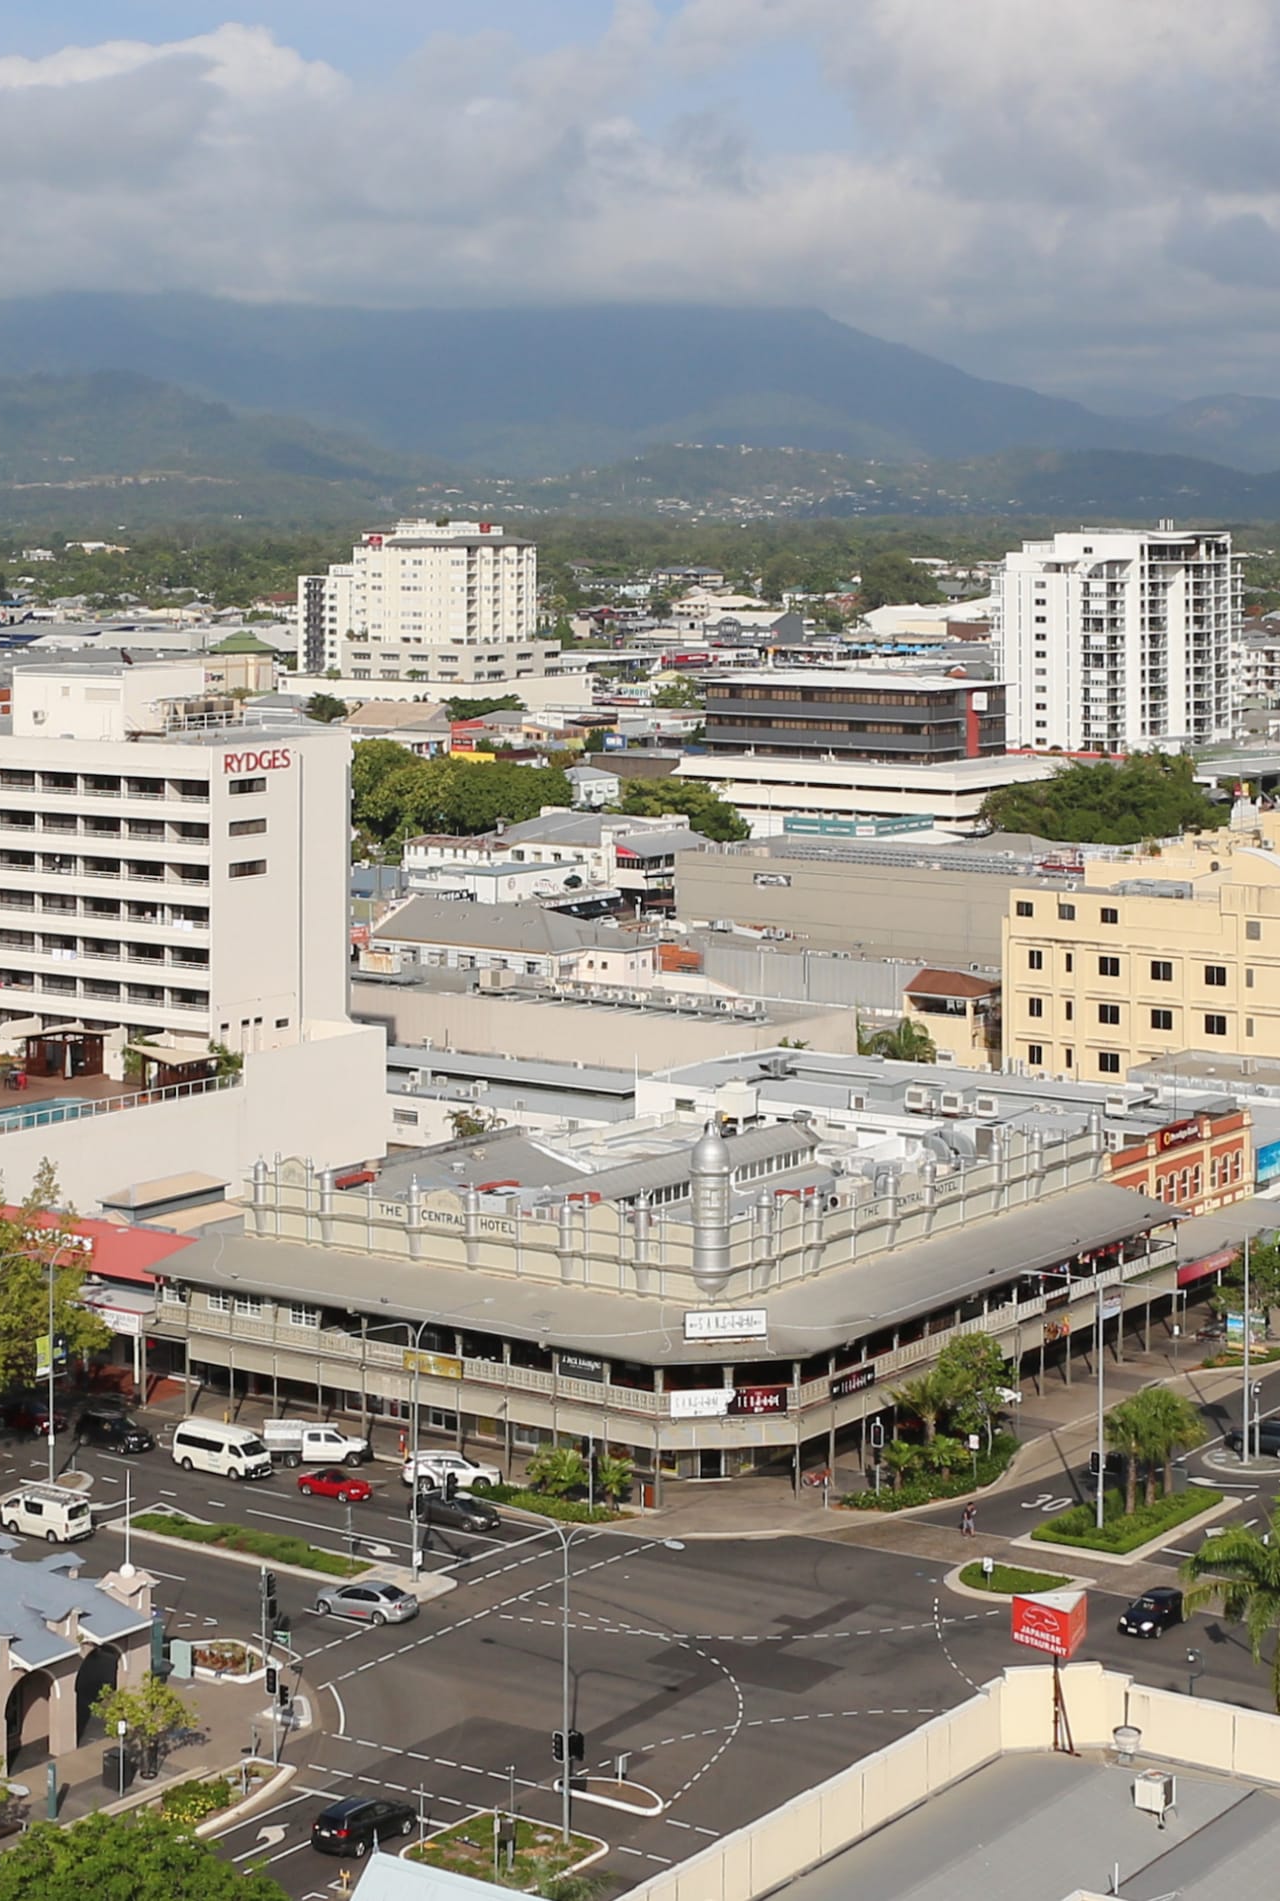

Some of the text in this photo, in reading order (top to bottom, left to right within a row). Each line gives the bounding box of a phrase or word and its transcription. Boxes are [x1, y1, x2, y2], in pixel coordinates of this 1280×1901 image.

[224, 748, 292, 774] RYDGES
[379, 1204, 516, 1235] THE CENTRAL HOTEL
[863, 1204, 880, 1217] THE
[1021, 1494, 1073, 1511] 30
[1013, 1631, 1068, 1657] RESTAURANT
[1021, 1624, 1063, 1646] JAPANESE
